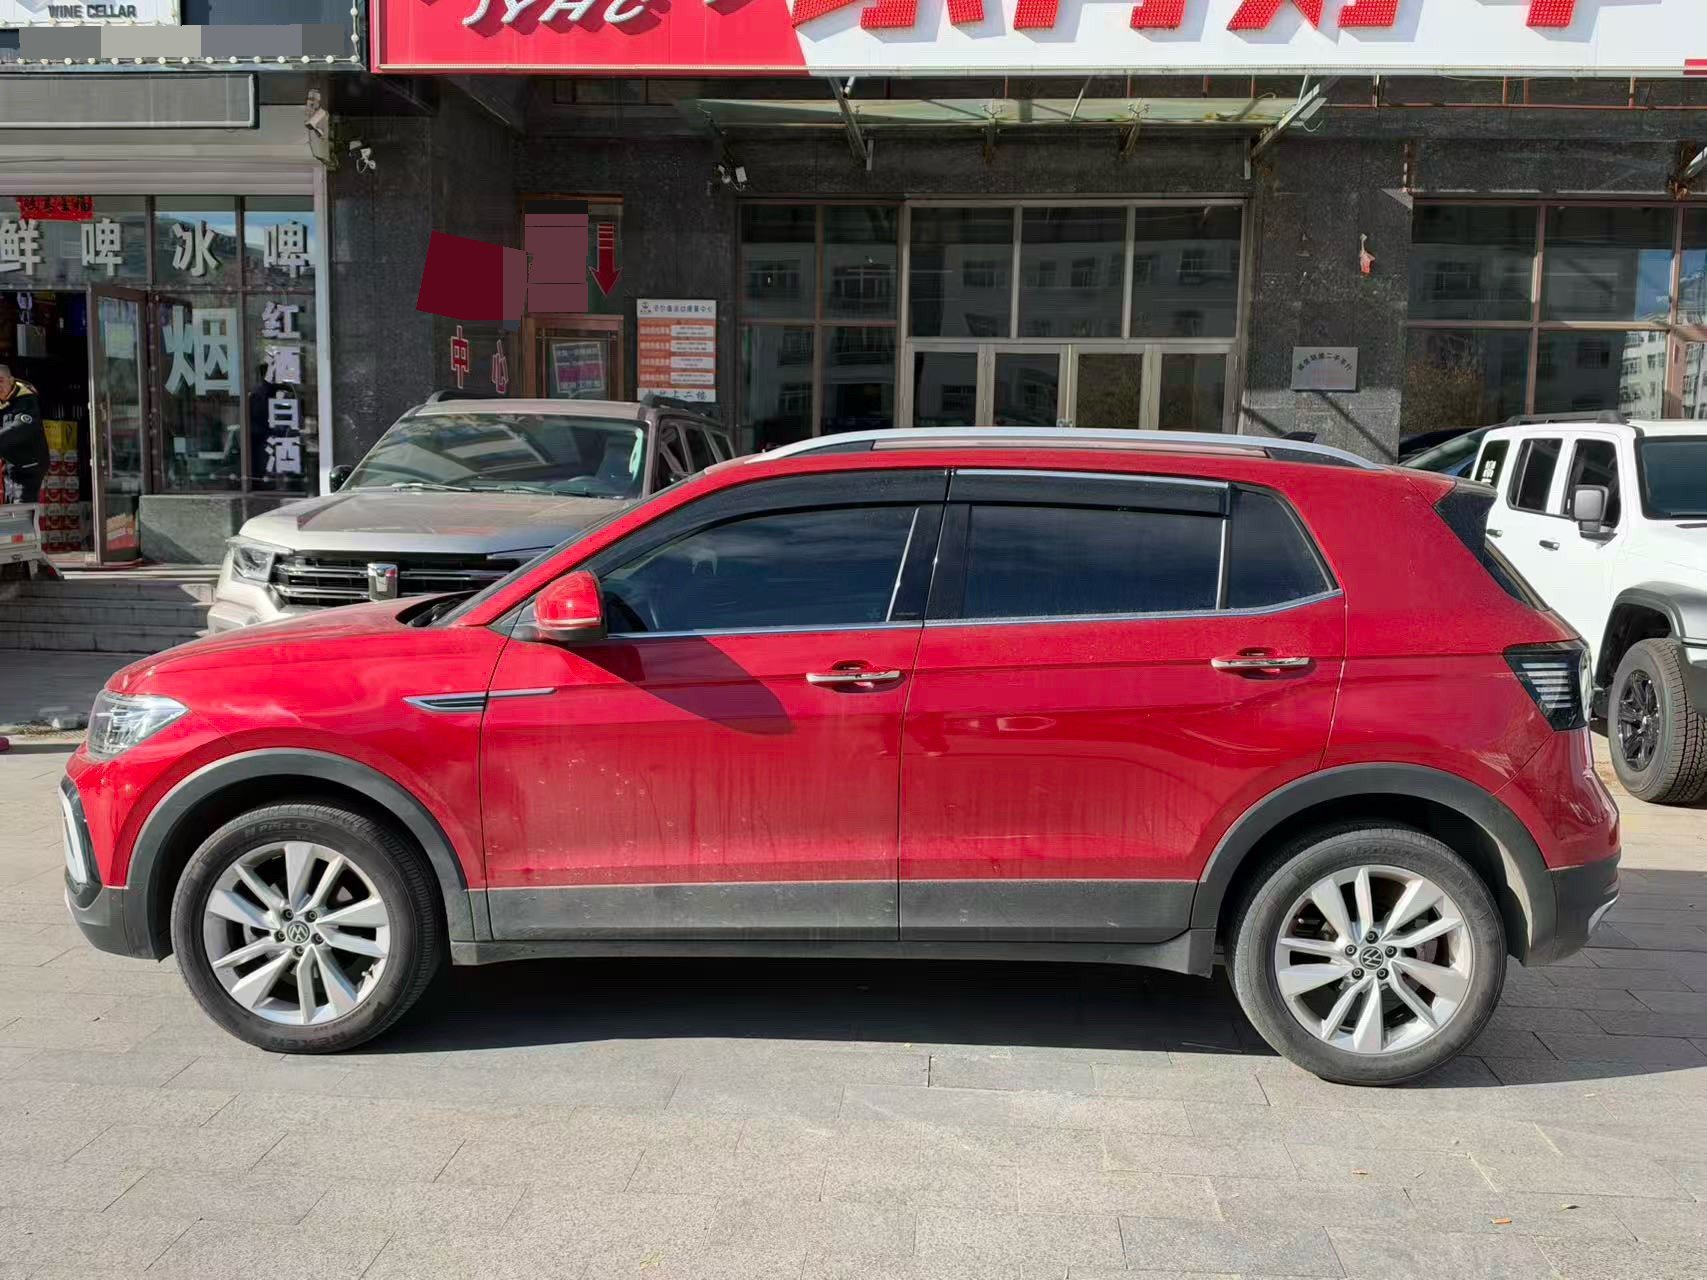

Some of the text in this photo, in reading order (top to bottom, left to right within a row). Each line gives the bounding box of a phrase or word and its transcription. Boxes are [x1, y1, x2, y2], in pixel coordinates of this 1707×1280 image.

[49, 5, 137, 18] WINE CELLAR
[162, 305, 241, 396] 烟
[262, 301, 301, 474] 红酒白酒
